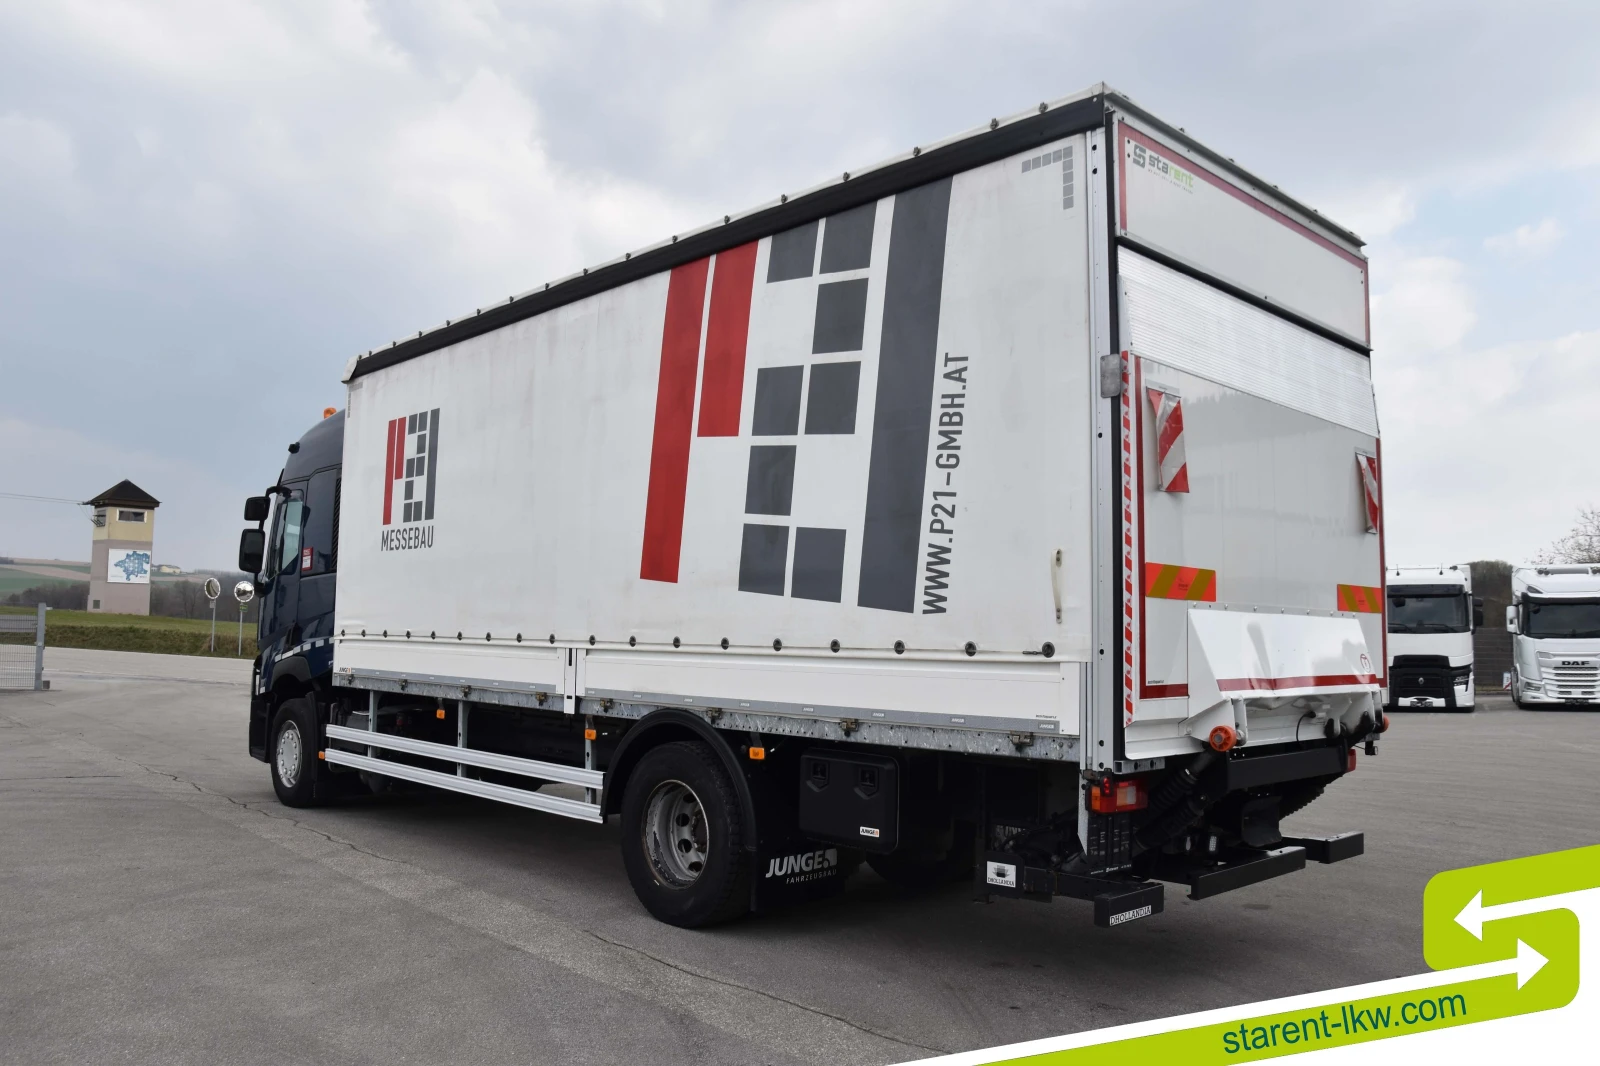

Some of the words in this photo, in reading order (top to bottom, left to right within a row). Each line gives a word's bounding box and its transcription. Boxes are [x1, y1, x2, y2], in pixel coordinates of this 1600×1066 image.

[1148, 154, 1194, 188] starent
[922, 352, 969, 615] WWW.P21-GMBH.AT
[381, 525, 434, 552] MESSEBAU
[765, 850, 824, 878] JUNGE
[786, 869, 837, 885] FAHRZEUGBAU
[1110, 905, 1152, 926] DHOLLANDIA
